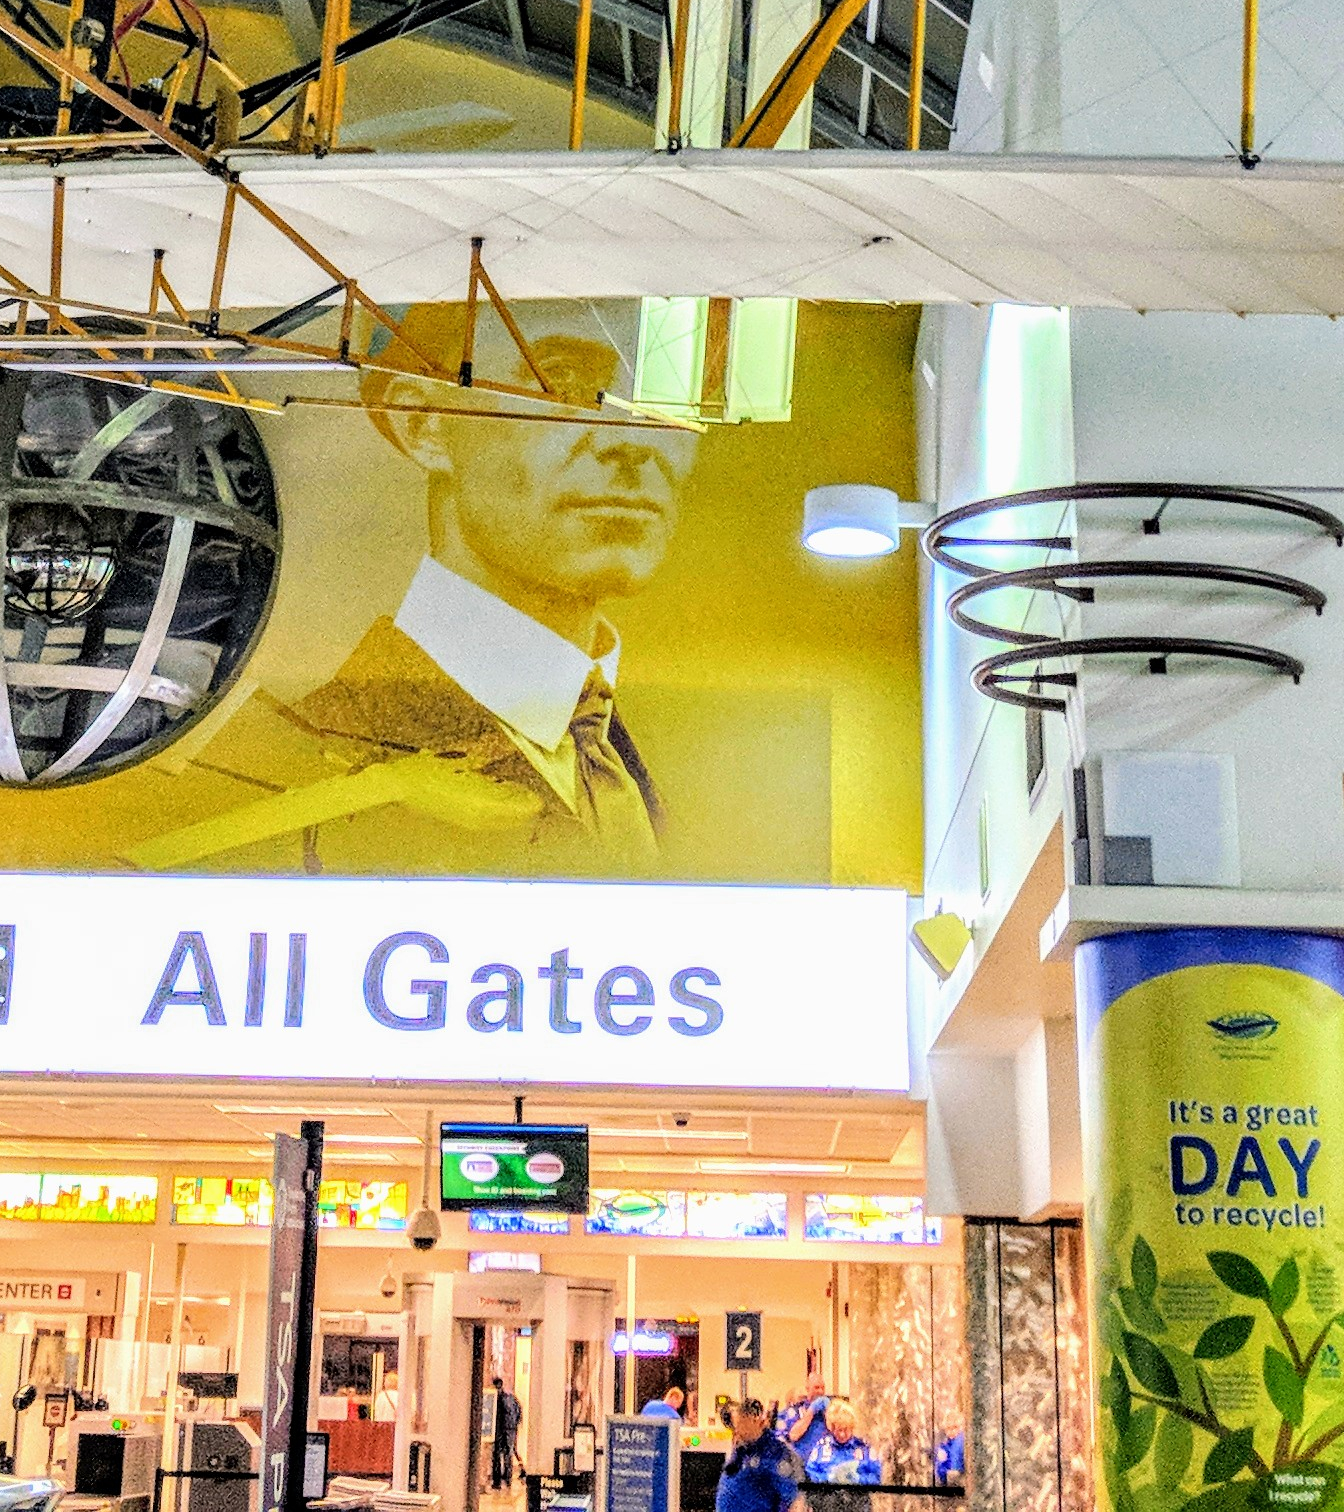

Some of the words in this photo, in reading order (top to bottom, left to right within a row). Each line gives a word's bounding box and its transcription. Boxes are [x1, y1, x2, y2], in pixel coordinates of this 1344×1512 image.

[140, 930, 308, 1029] All
[362, 930, 726, 1037] Gates
[1169, 1100, 1215, 1125] It's
[1222, 1105, 1238, 1125] a
[1246, 1105, 1319, 1132] great
[1169, 1135, 1322, 1199] DAY
[1175, 1203, 1206, 1226] to
[1212, 1203, 1326, 1234] recycle!
[271, 1271, 296, 1428] TSA
[735, 1326, 753, 1358] 2
